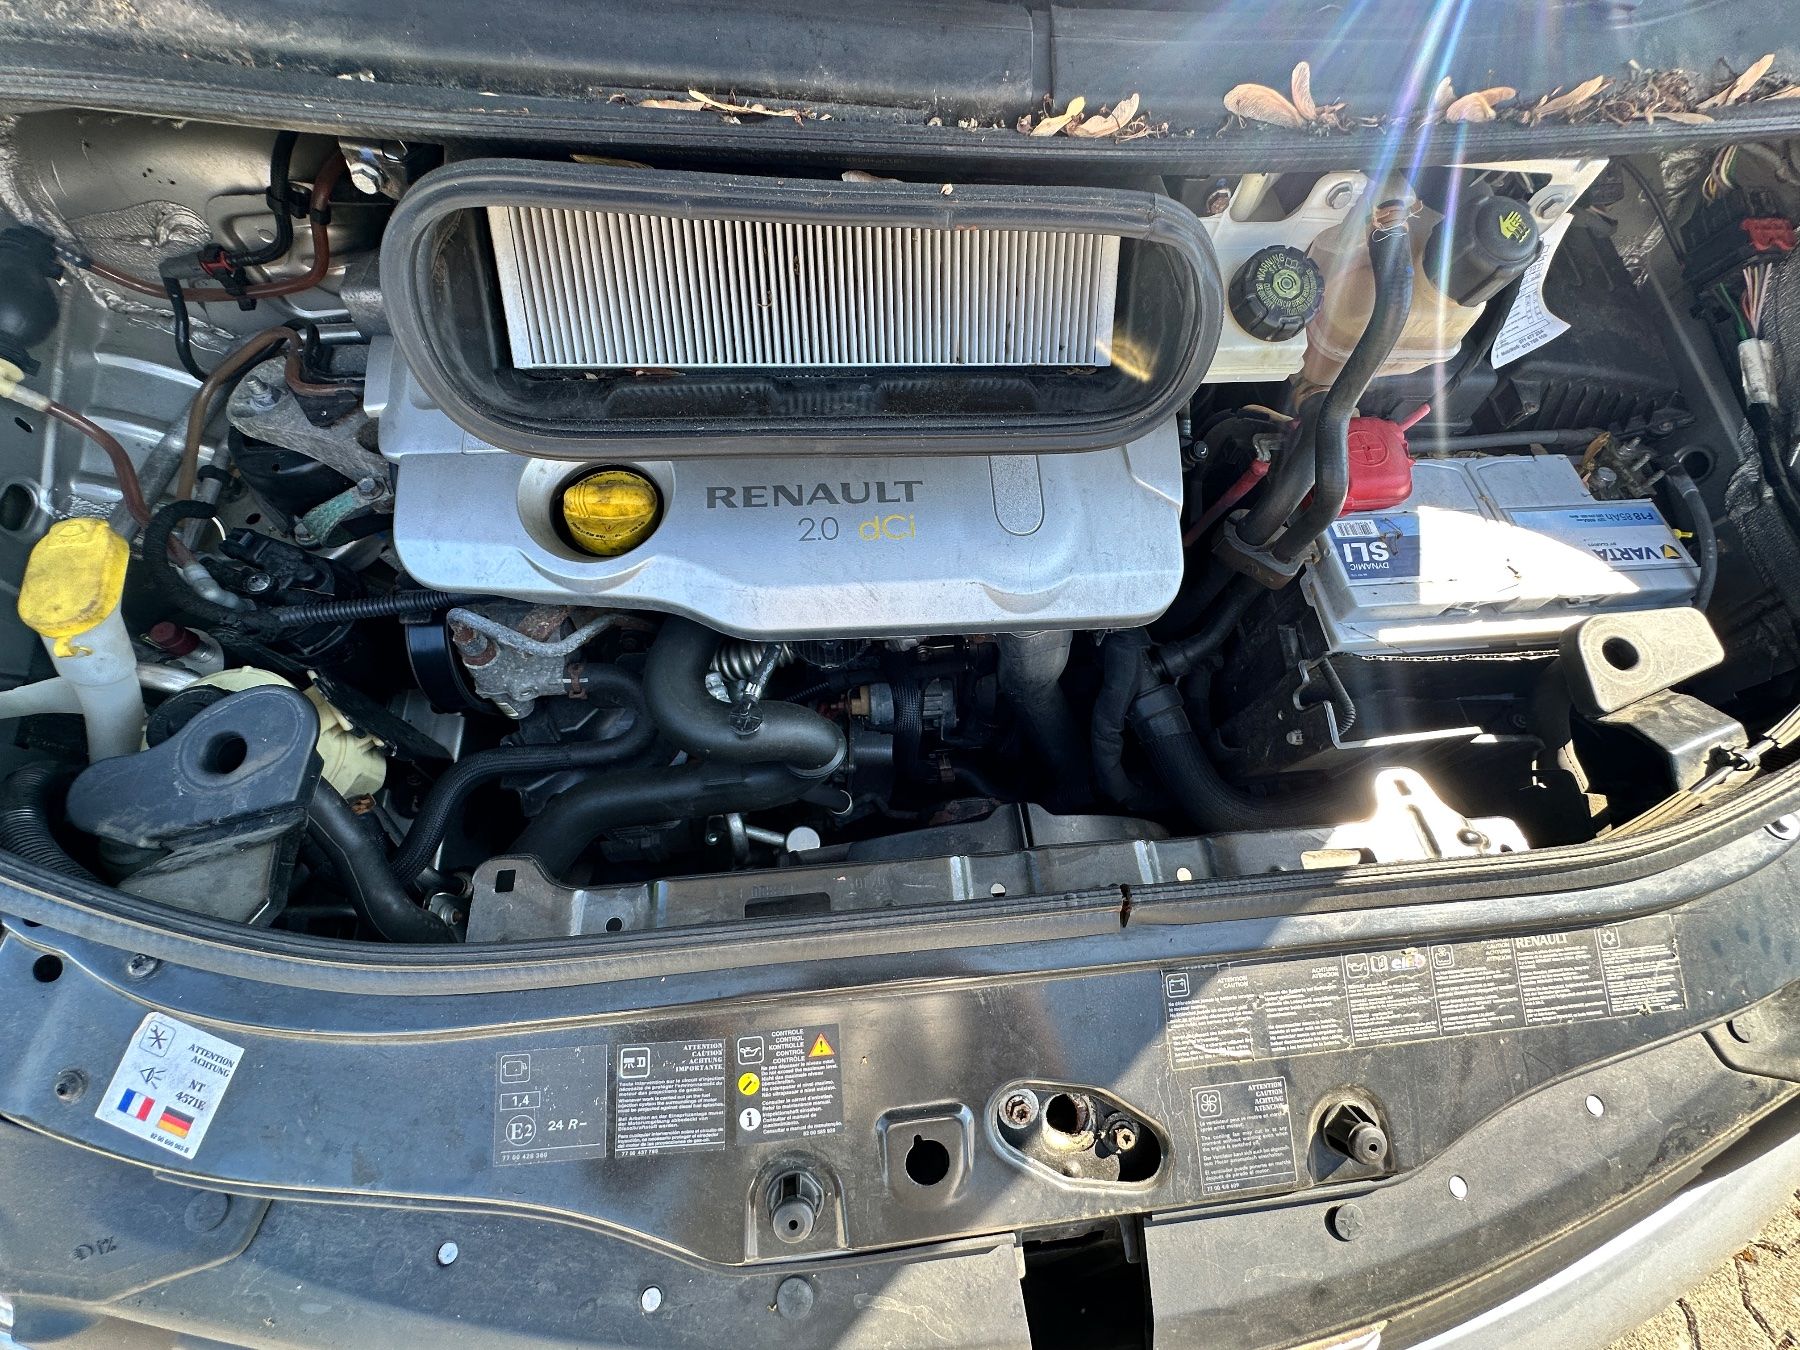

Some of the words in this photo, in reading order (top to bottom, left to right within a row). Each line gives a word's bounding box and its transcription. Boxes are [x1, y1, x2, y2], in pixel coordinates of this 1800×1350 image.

[1257, 253, 1284, 280] WARNING
[706, 480, 923, 509] RENAULT
[798, 516, 839, 541] 2.0
[858, 513, 916, 541] dCi
[1343, 542, 1389, 562] SLI
[1592, 547, 1661, 561] VARTA
[1350, 562, 1389, 570] DYNAMIC
[1516, 933, 1568, 948] RENAULT
[1217, 975, 1247, 983] ATTENTION
[772, 1029, 804, 1037] CONTROLE
[769, 1042, 804, 1050] KONTROLLE
[188, 1044, 235, 1068] ATTENTION
[776, 1049, 805, 1057] CONTROL
[190, 1055, 231, 1078] ACHTUNG
[189, 1079, 207, 1093] NT
[1248, 1081, 1283, 1091] ATTENTION
[1256, 1088, 1283, 1097] CAUTION
[512, 1095, 530, 1107] 1,4
[1254, 1096, 1283, 1105] ACHTUNG
[510, 1123, 532, 1140] E2
[548, 1120, 564, 1131] 24
